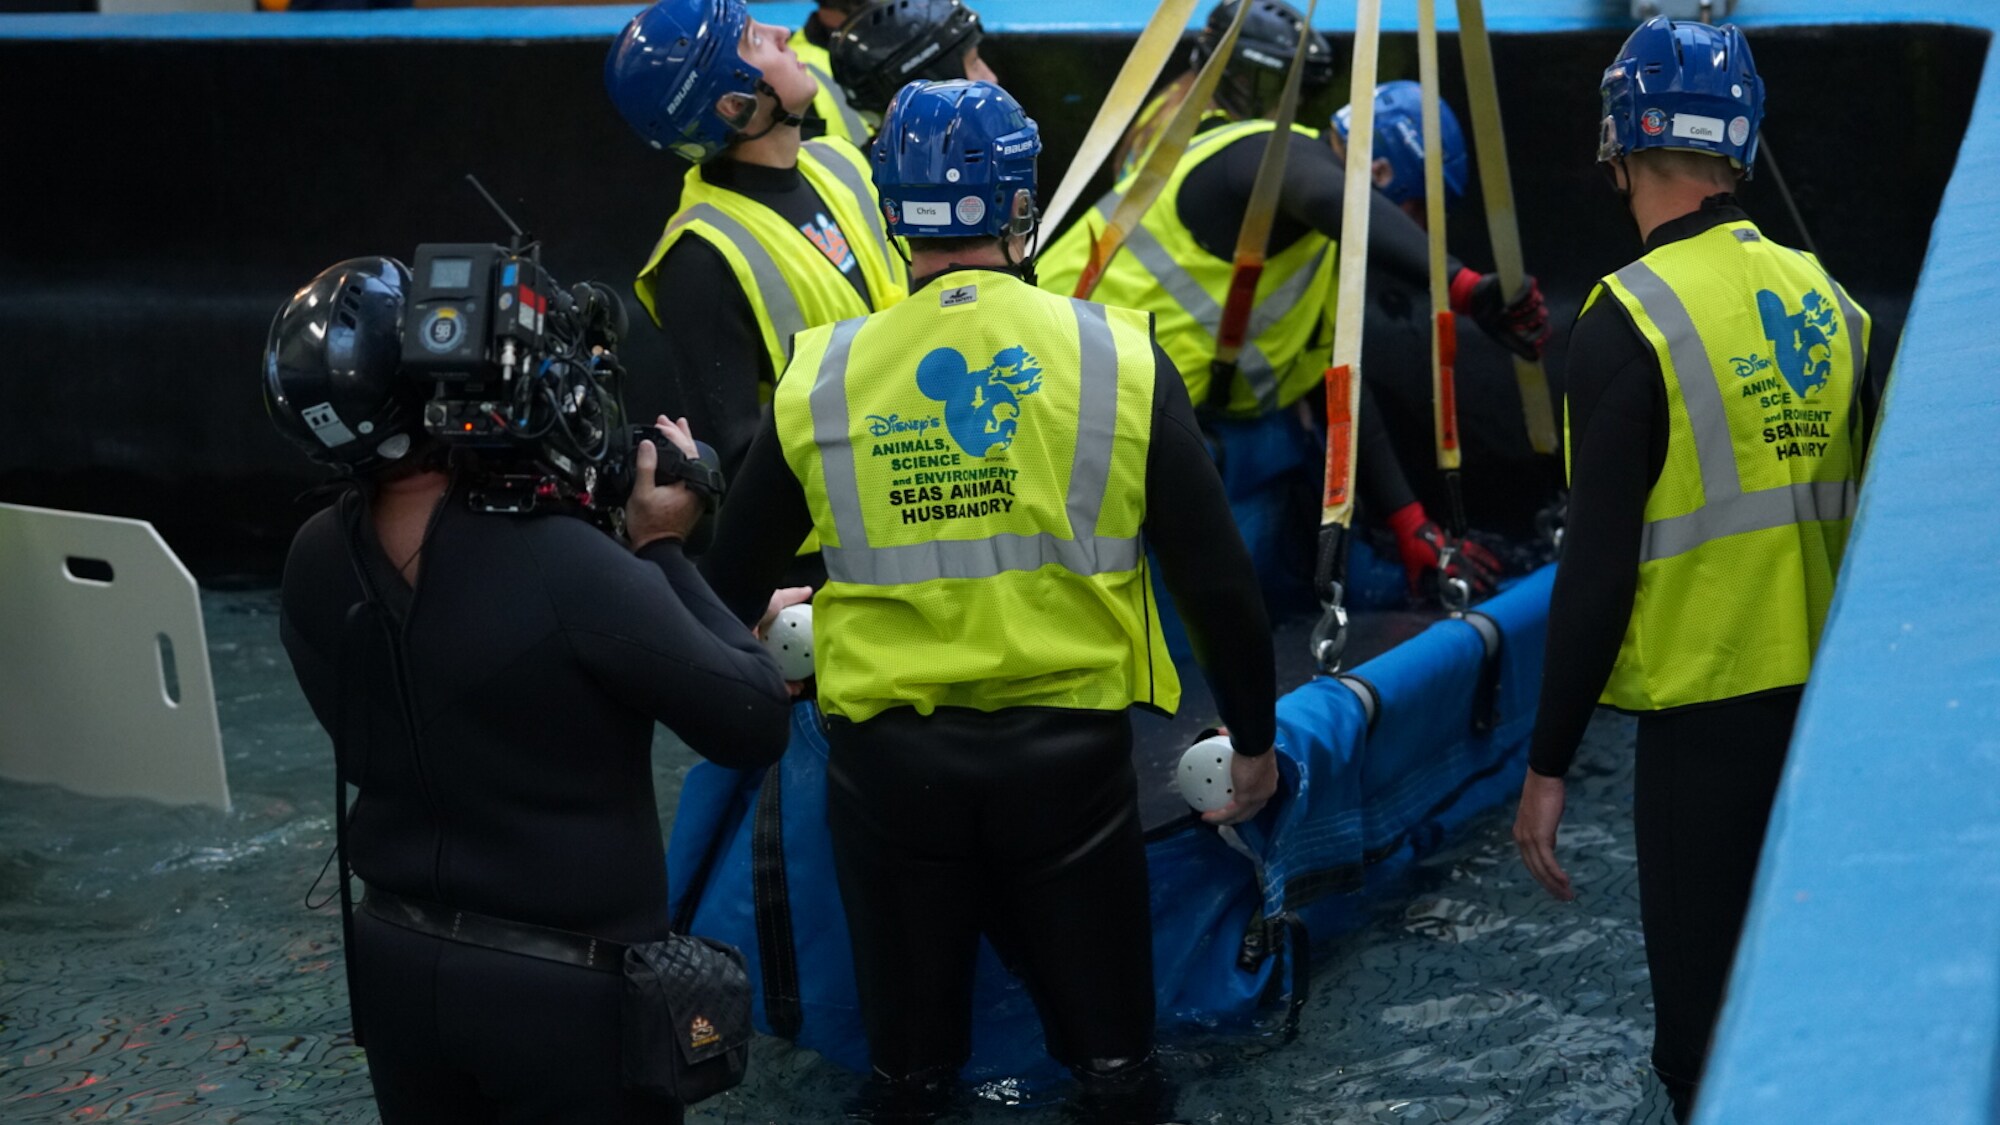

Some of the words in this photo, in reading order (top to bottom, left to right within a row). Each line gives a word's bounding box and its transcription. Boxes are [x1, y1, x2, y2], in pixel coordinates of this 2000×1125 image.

[1690, 126, 1713, 137] Collin
[1004, 139, 1033, 155] BAUER
[916, 207, 937, 215] Chris
[865, 413, 940, 437] Disney's
[872, 438, 950, 456] ANIMALS,
[891, 453, 961, 471] SCIENCE
[892, 476, 912, 486] and
[914, 466, 1019, 485] ENVIRONMENT
[889, 485, 943, 506] SEAS
[950, 479, 1016, 500] ANIMAL
[901, 497, 1013, 525] HUSBANDRY
